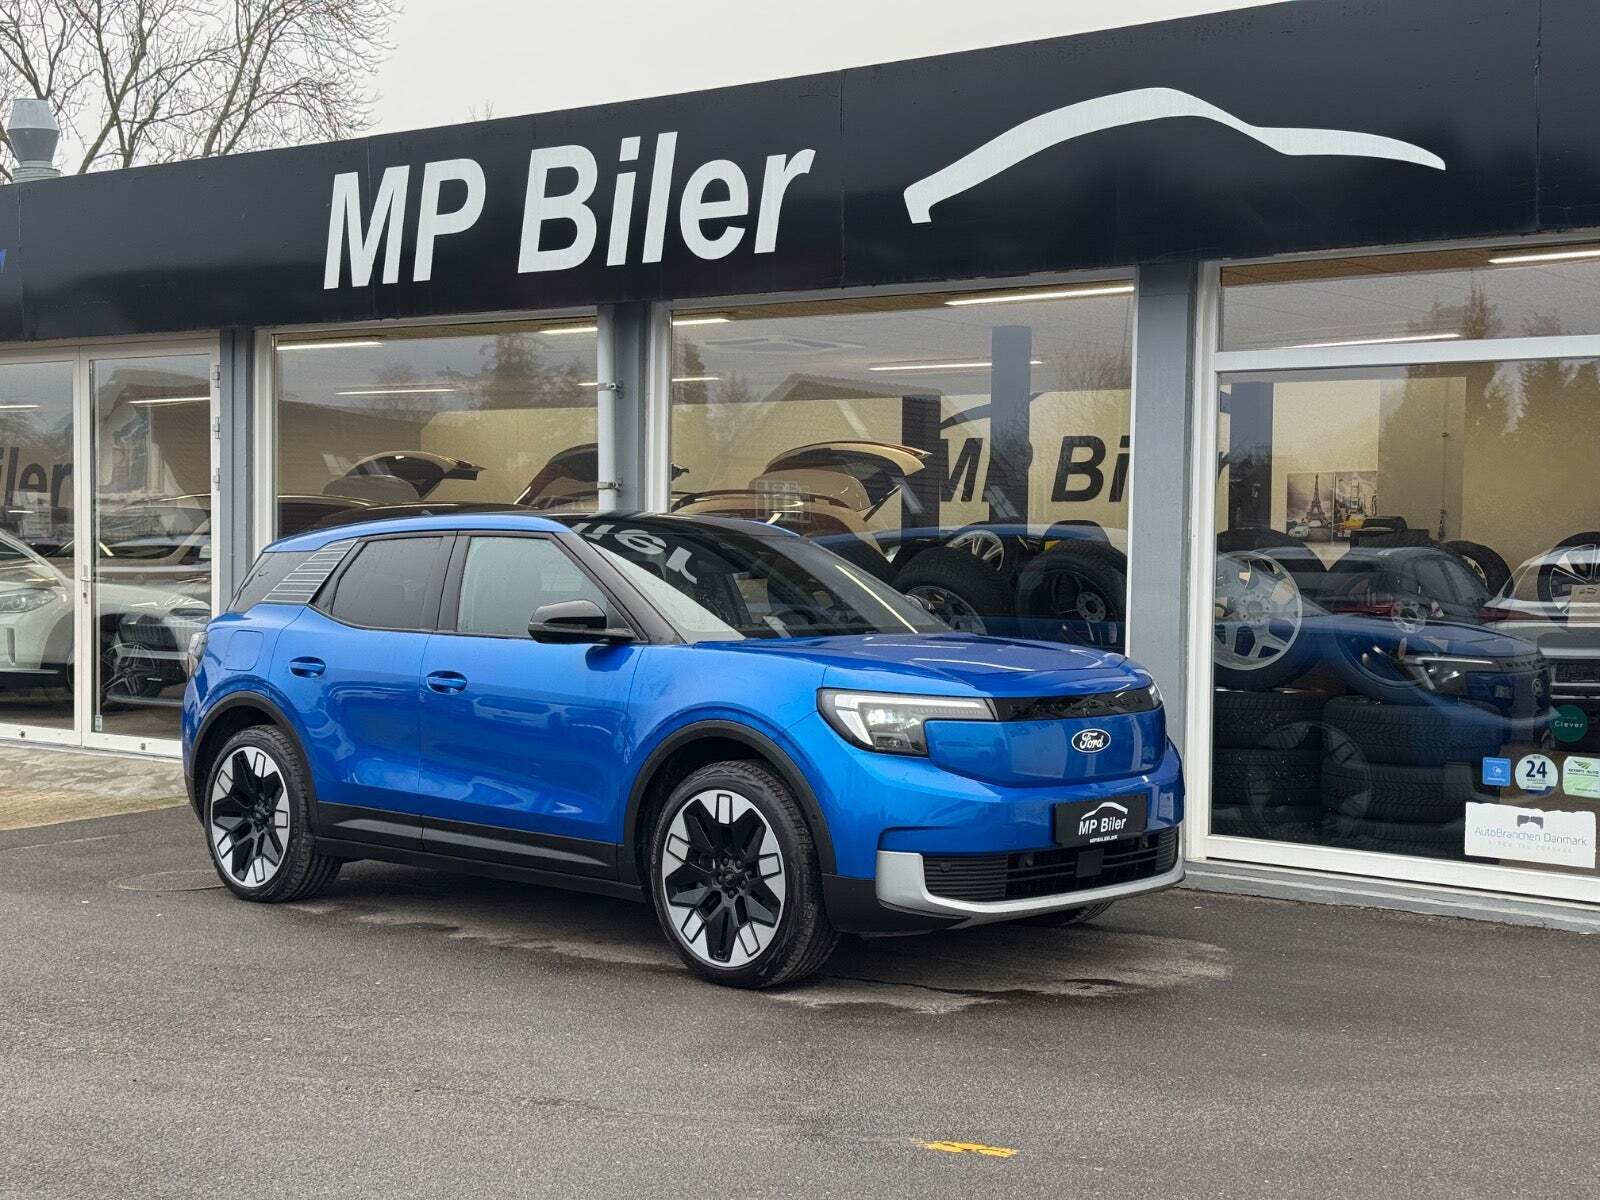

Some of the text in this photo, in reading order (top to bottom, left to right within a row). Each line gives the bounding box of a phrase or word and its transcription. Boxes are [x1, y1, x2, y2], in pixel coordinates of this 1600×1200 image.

[323, 131, 816, 290] MP Biler
[1554, 720, 1584, 728] Clever
[1079, 732, 1104, 749] Ford
[1525, 760, 1548, 779] 24
[1078, 816, 1127, 836] MP Biler
[1474, 826, 1587, 846] AutoBranchen Danmark
